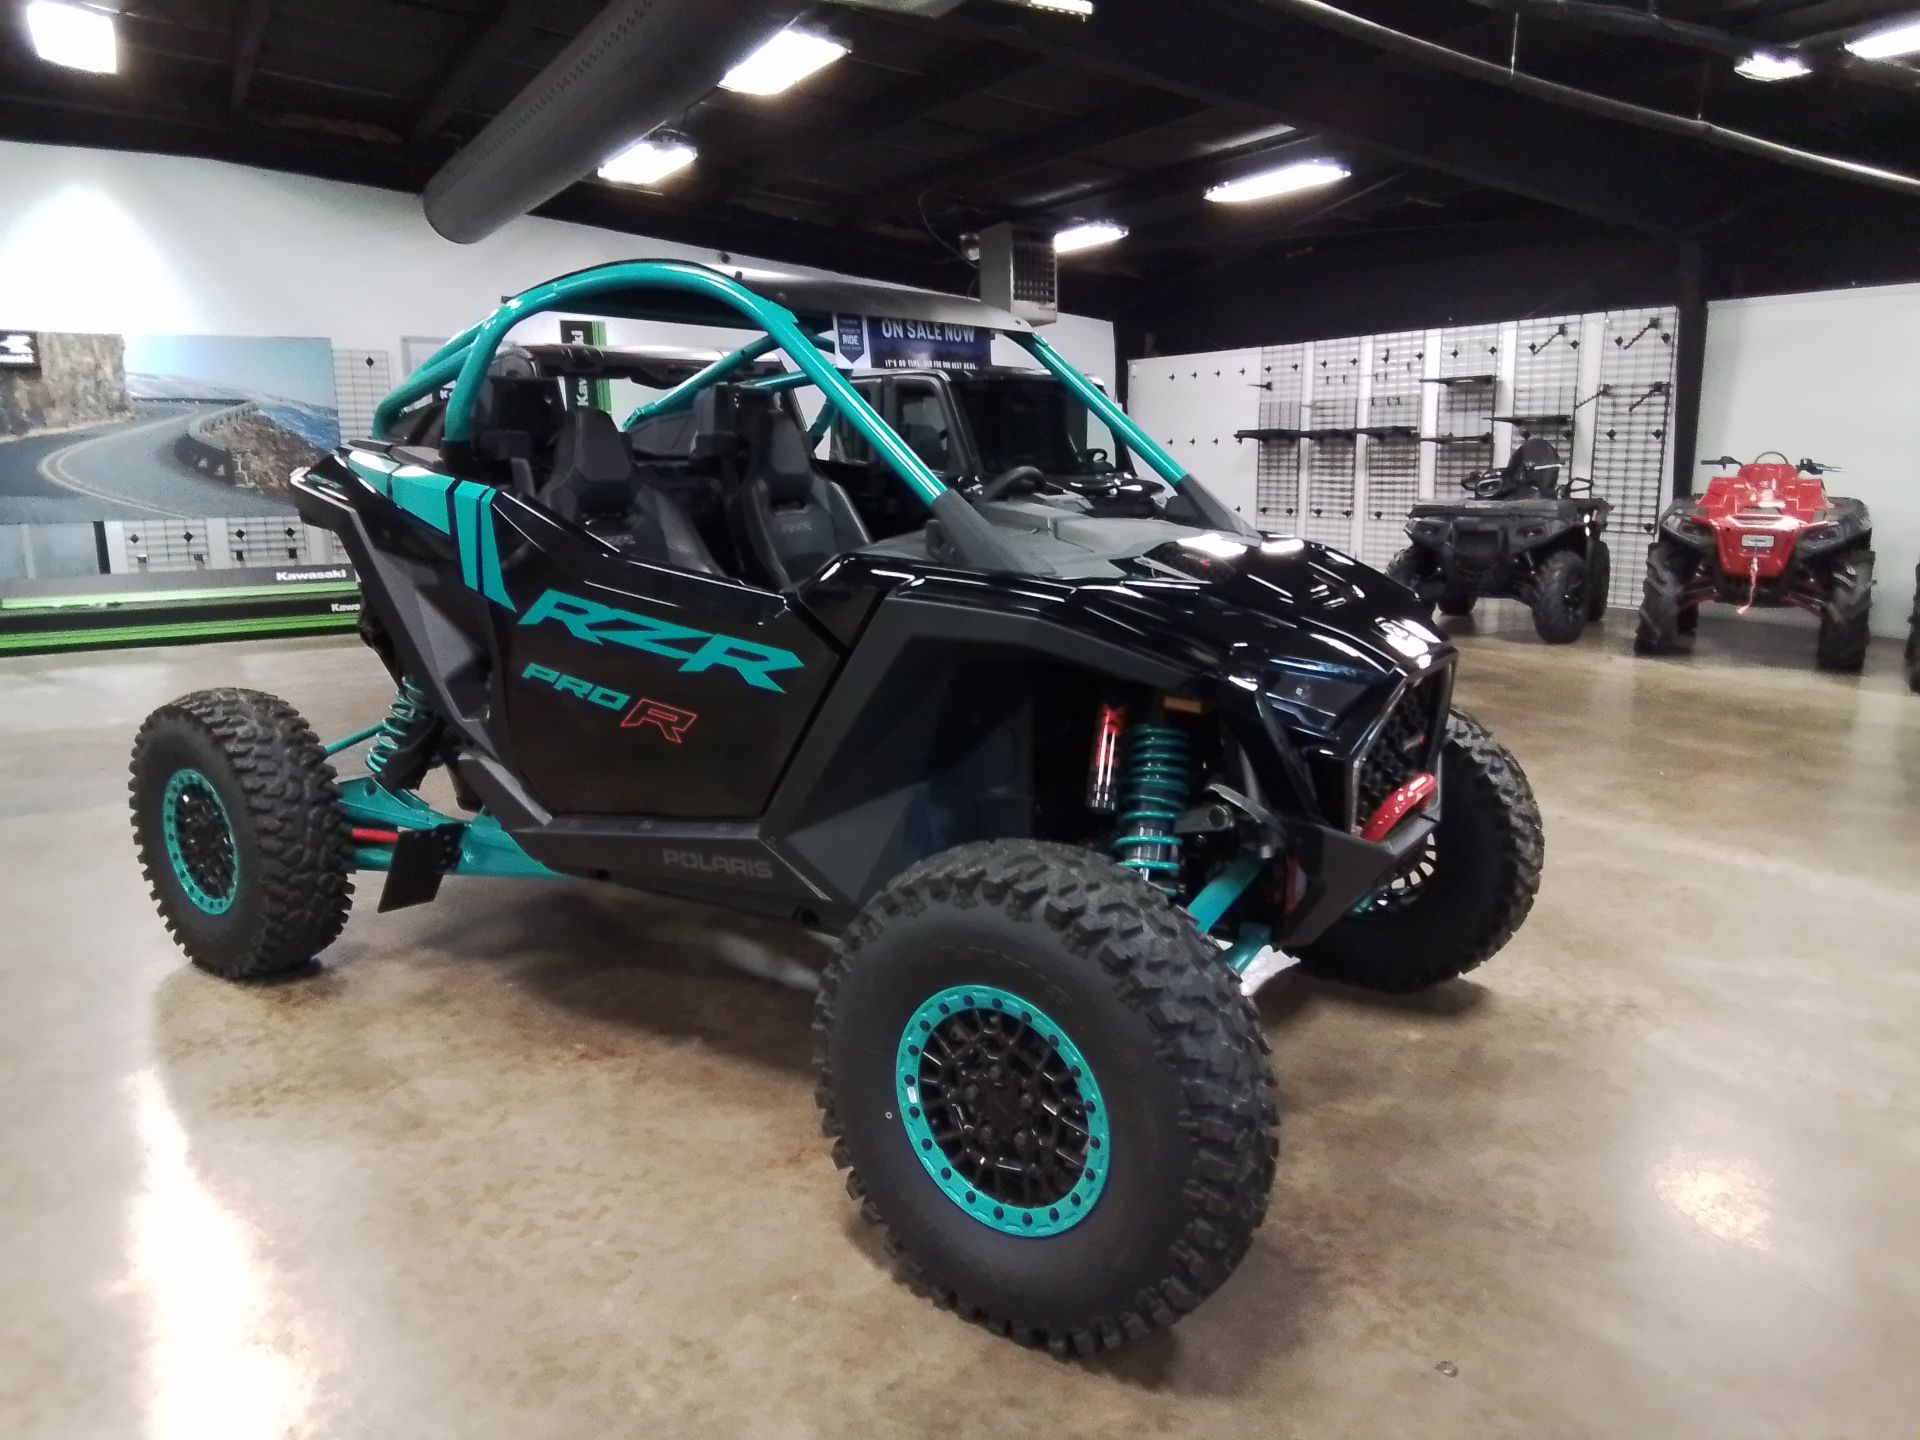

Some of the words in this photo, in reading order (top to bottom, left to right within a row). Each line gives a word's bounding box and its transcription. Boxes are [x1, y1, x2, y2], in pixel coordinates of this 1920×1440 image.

[842, 334, 860, 346] RIDE
[882, 320, 903, 339] ON
[907, 322, 942, 341] SALE
[945, 324, 975, 343] NOW
[276, 569, 347, 581] Kawasaki
[330, 603, 361, 612] Kawa
[517, 589, 804, 694] RZR
[521, 662, 631, 711] PRO
[620, 698, 697, 743] R
[662, 848, 773, 880] POLARIS
